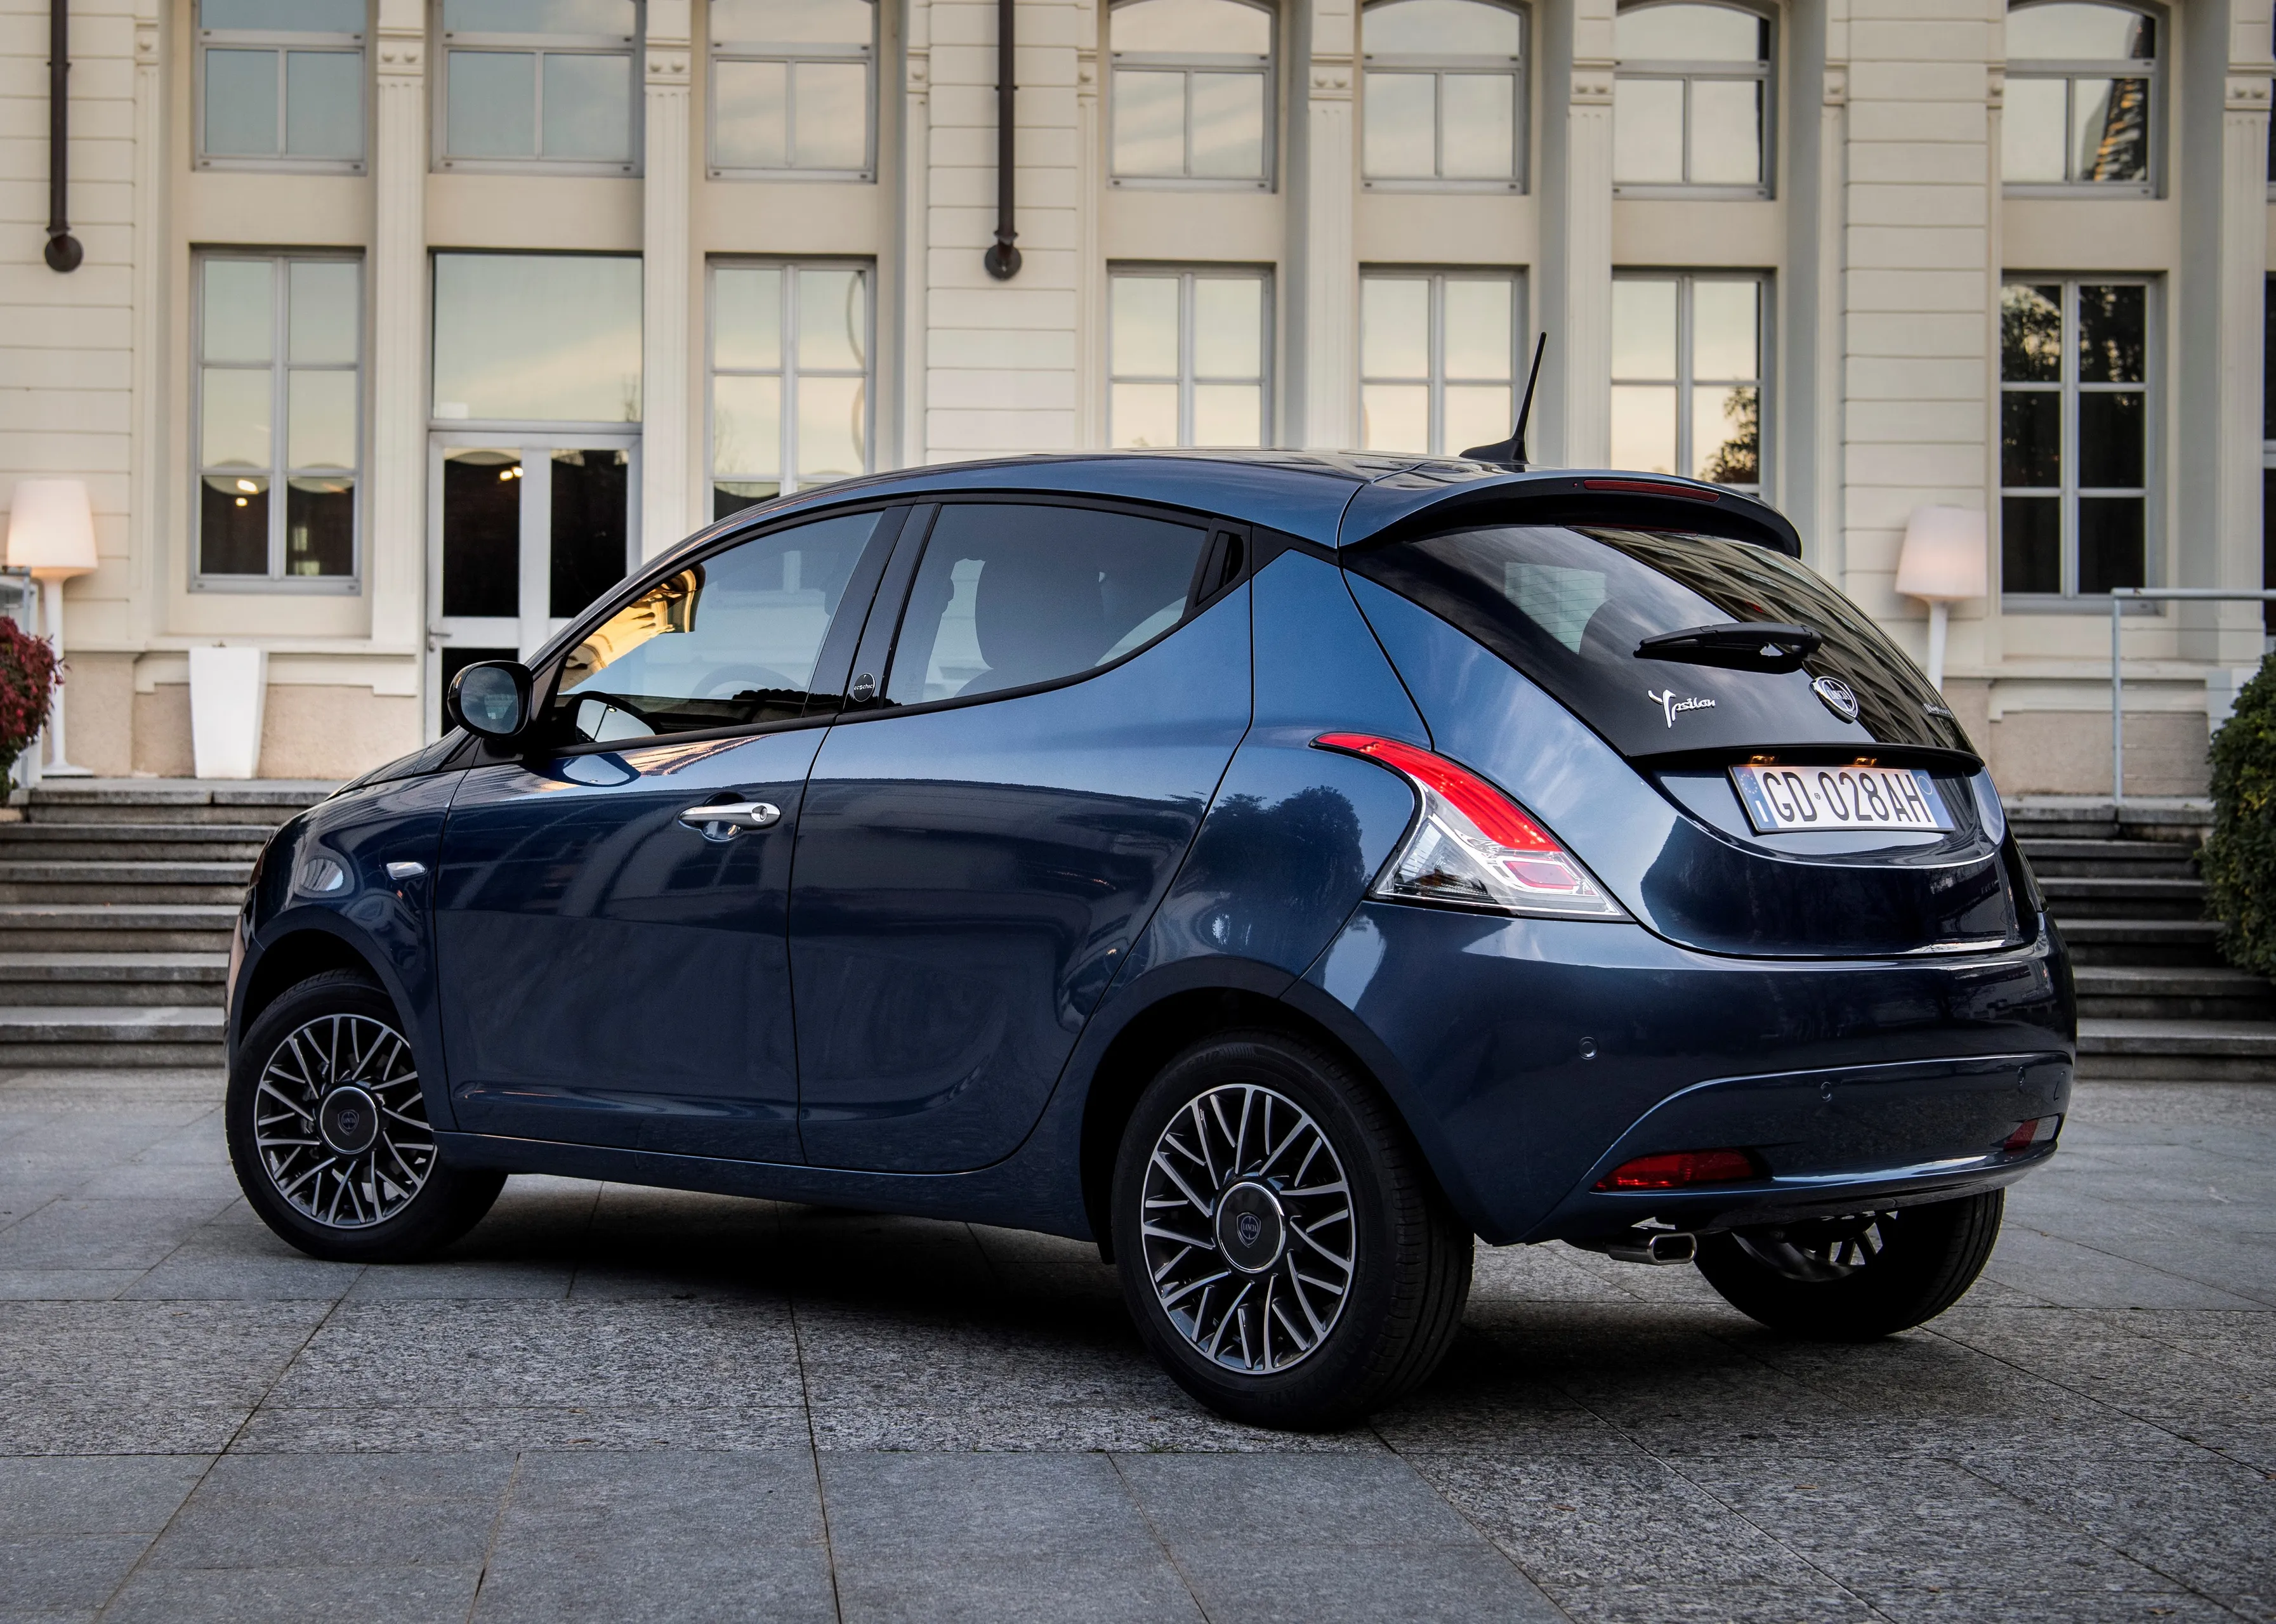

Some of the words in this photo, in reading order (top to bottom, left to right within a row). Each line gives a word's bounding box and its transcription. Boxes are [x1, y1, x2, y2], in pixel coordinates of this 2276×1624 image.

[1648, 690, 1716, 728] Ypsilon
[1763, 771, 1817, 822] GD
[1242, 1222, 1257, 1232] LANCIA
